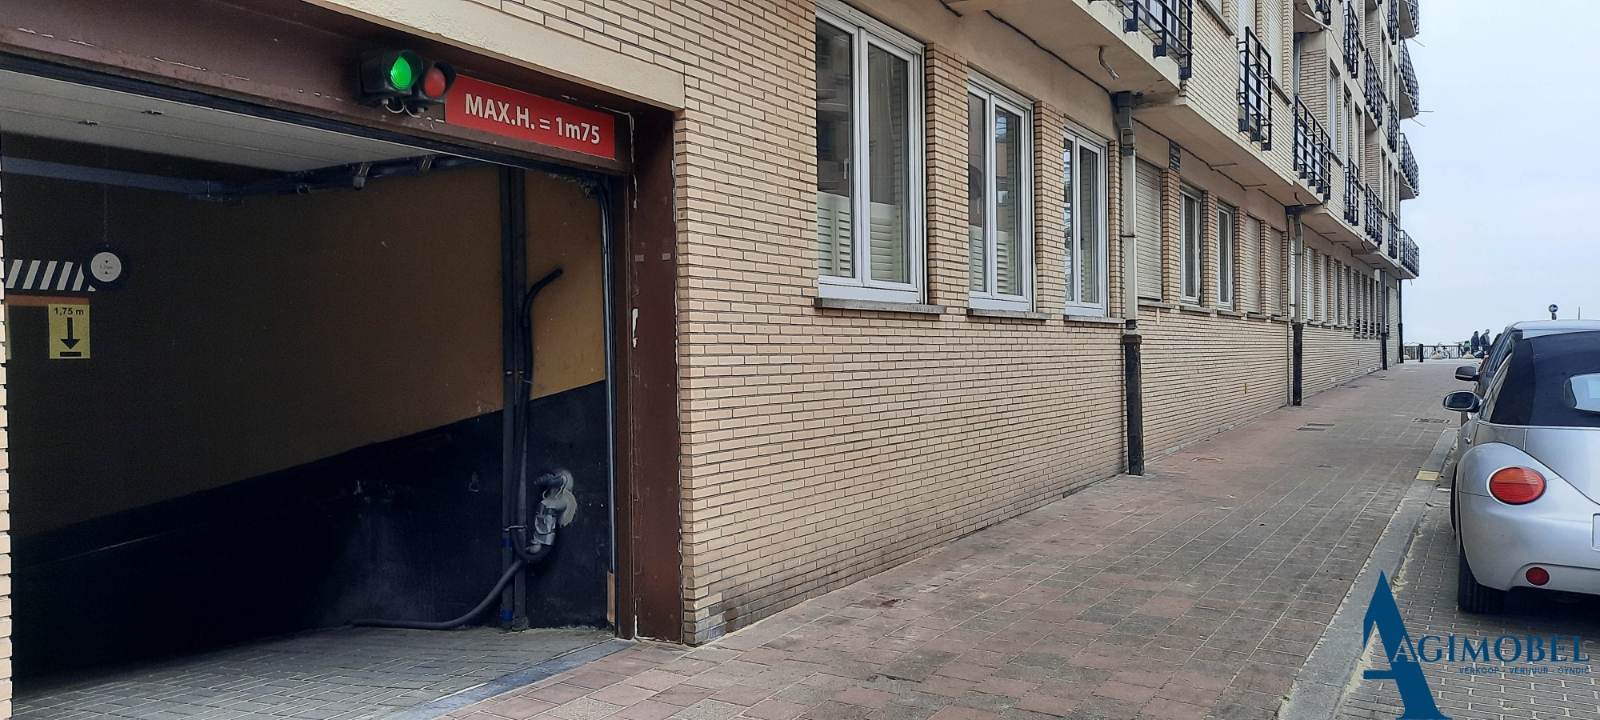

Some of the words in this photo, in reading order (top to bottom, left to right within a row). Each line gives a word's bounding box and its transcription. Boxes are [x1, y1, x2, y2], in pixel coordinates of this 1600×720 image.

[465, 93, 535, 130] MAX.H.
[555, 116, 601, 144] 1m75
[54, 307, 73, 316] 1,75
